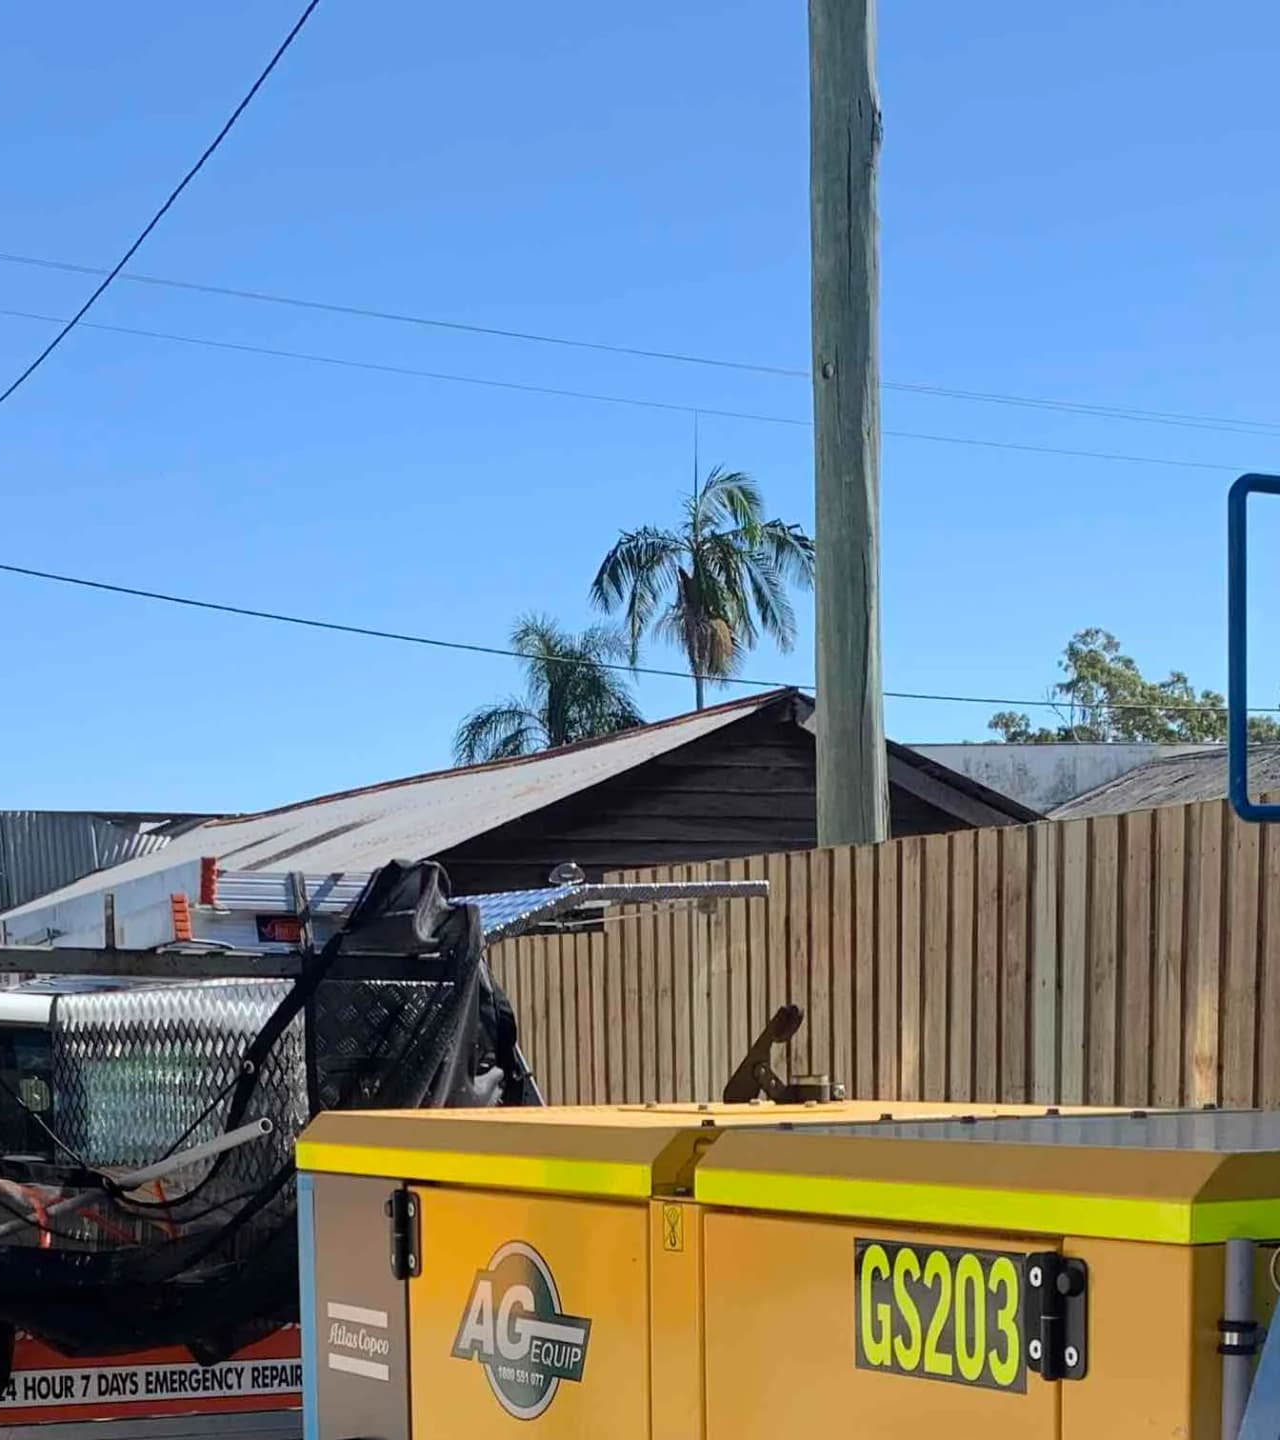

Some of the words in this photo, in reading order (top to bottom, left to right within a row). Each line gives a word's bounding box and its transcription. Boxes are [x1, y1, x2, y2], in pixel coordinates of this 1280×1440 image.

[458, 1279, 586, 1361] AG
[860, 1244, 1020, 1386] GS203
[327, 1322, 358, 1350] Atlas
[359, 1327, 390, 1357] Copco
[530, 1340, 582, 1370] EQUIP
[23, 1373, 76, 1401] HOUR
[80, 1374, 91, 1398] 7
[97, 1371, 139, 1397] DAYS
[145, 1367, 245, 1395] EMERGENCY
